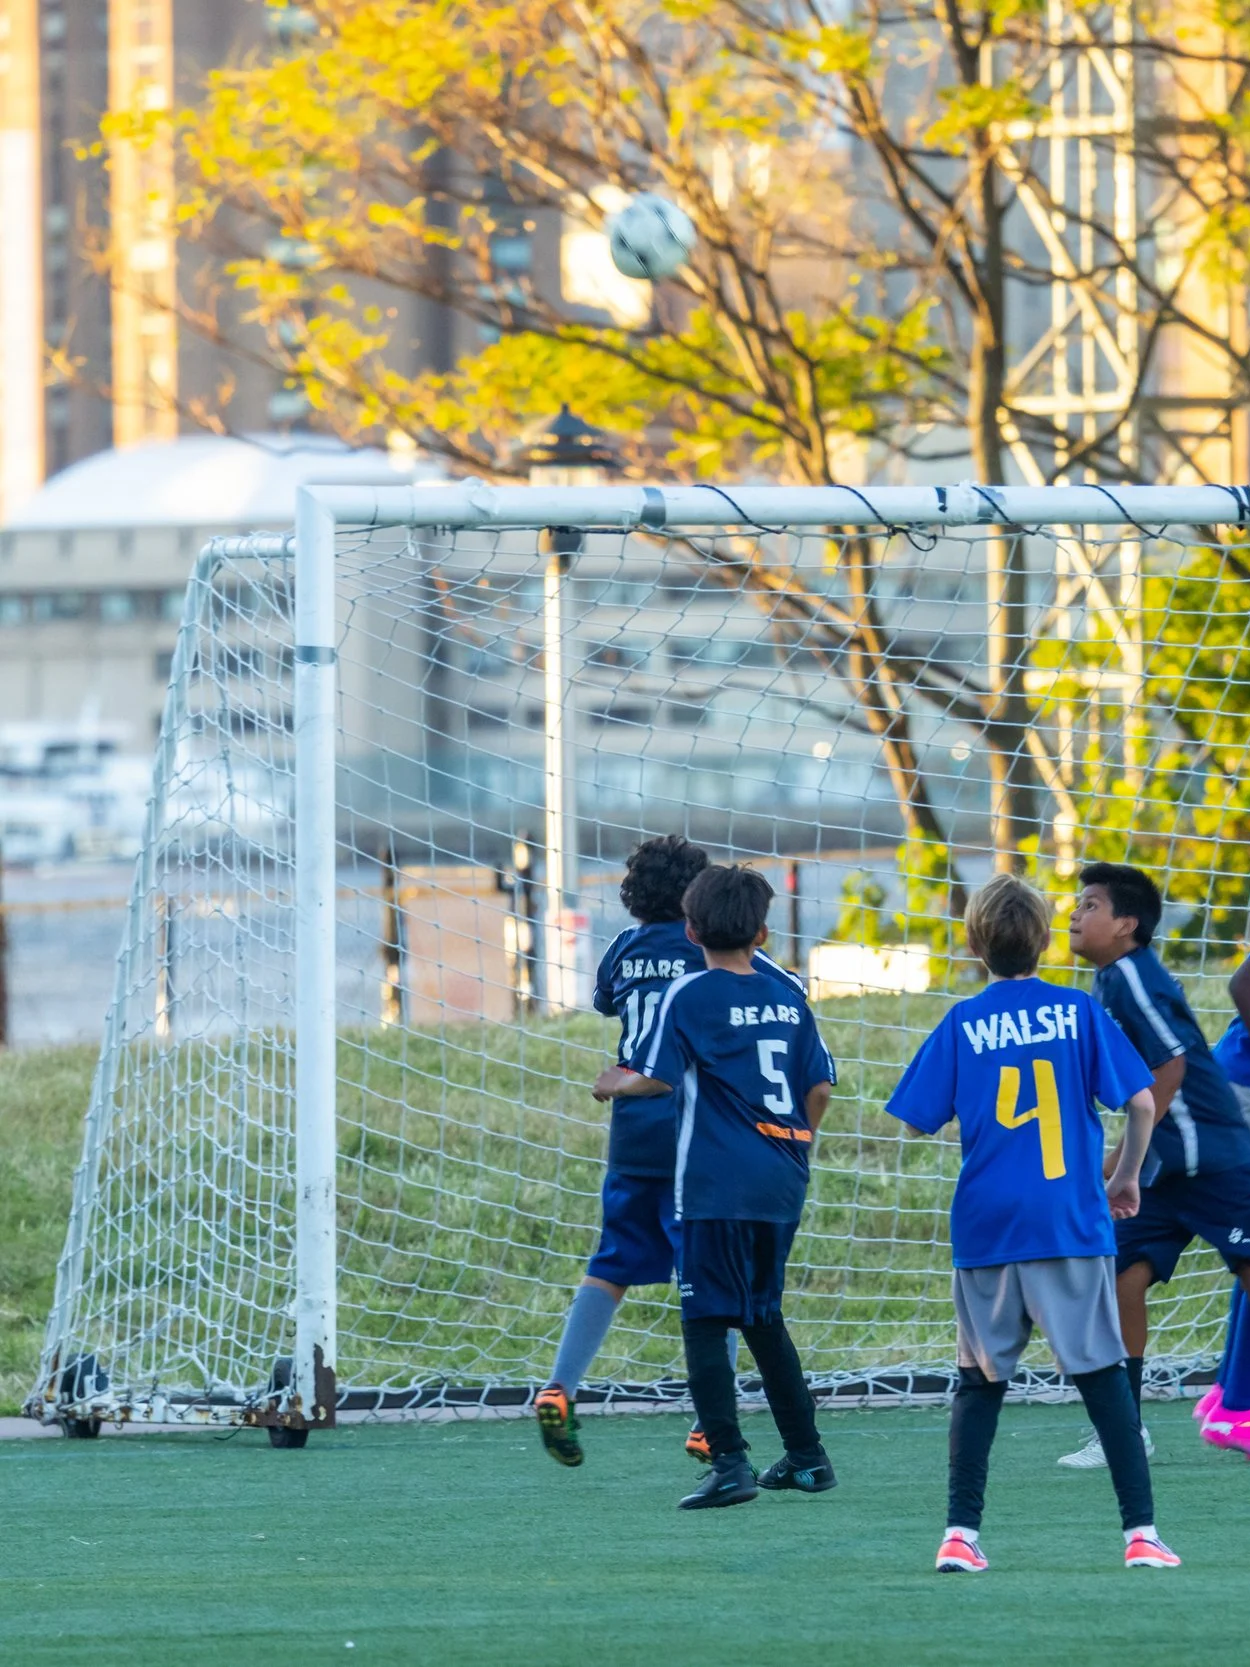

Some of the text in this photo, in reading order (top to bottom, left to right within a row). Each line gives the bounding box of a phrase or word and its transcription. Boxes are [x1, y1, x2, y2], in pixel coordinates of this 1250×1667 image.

[622, 959, 686, 979] BEARS
[729, 1004, 800, 1026] BEARS
[962, 1004, 1078, 1055] WALSH
[756, 1039, 794, 1115] 5
[996, 1059, 1067, 1180] 4
